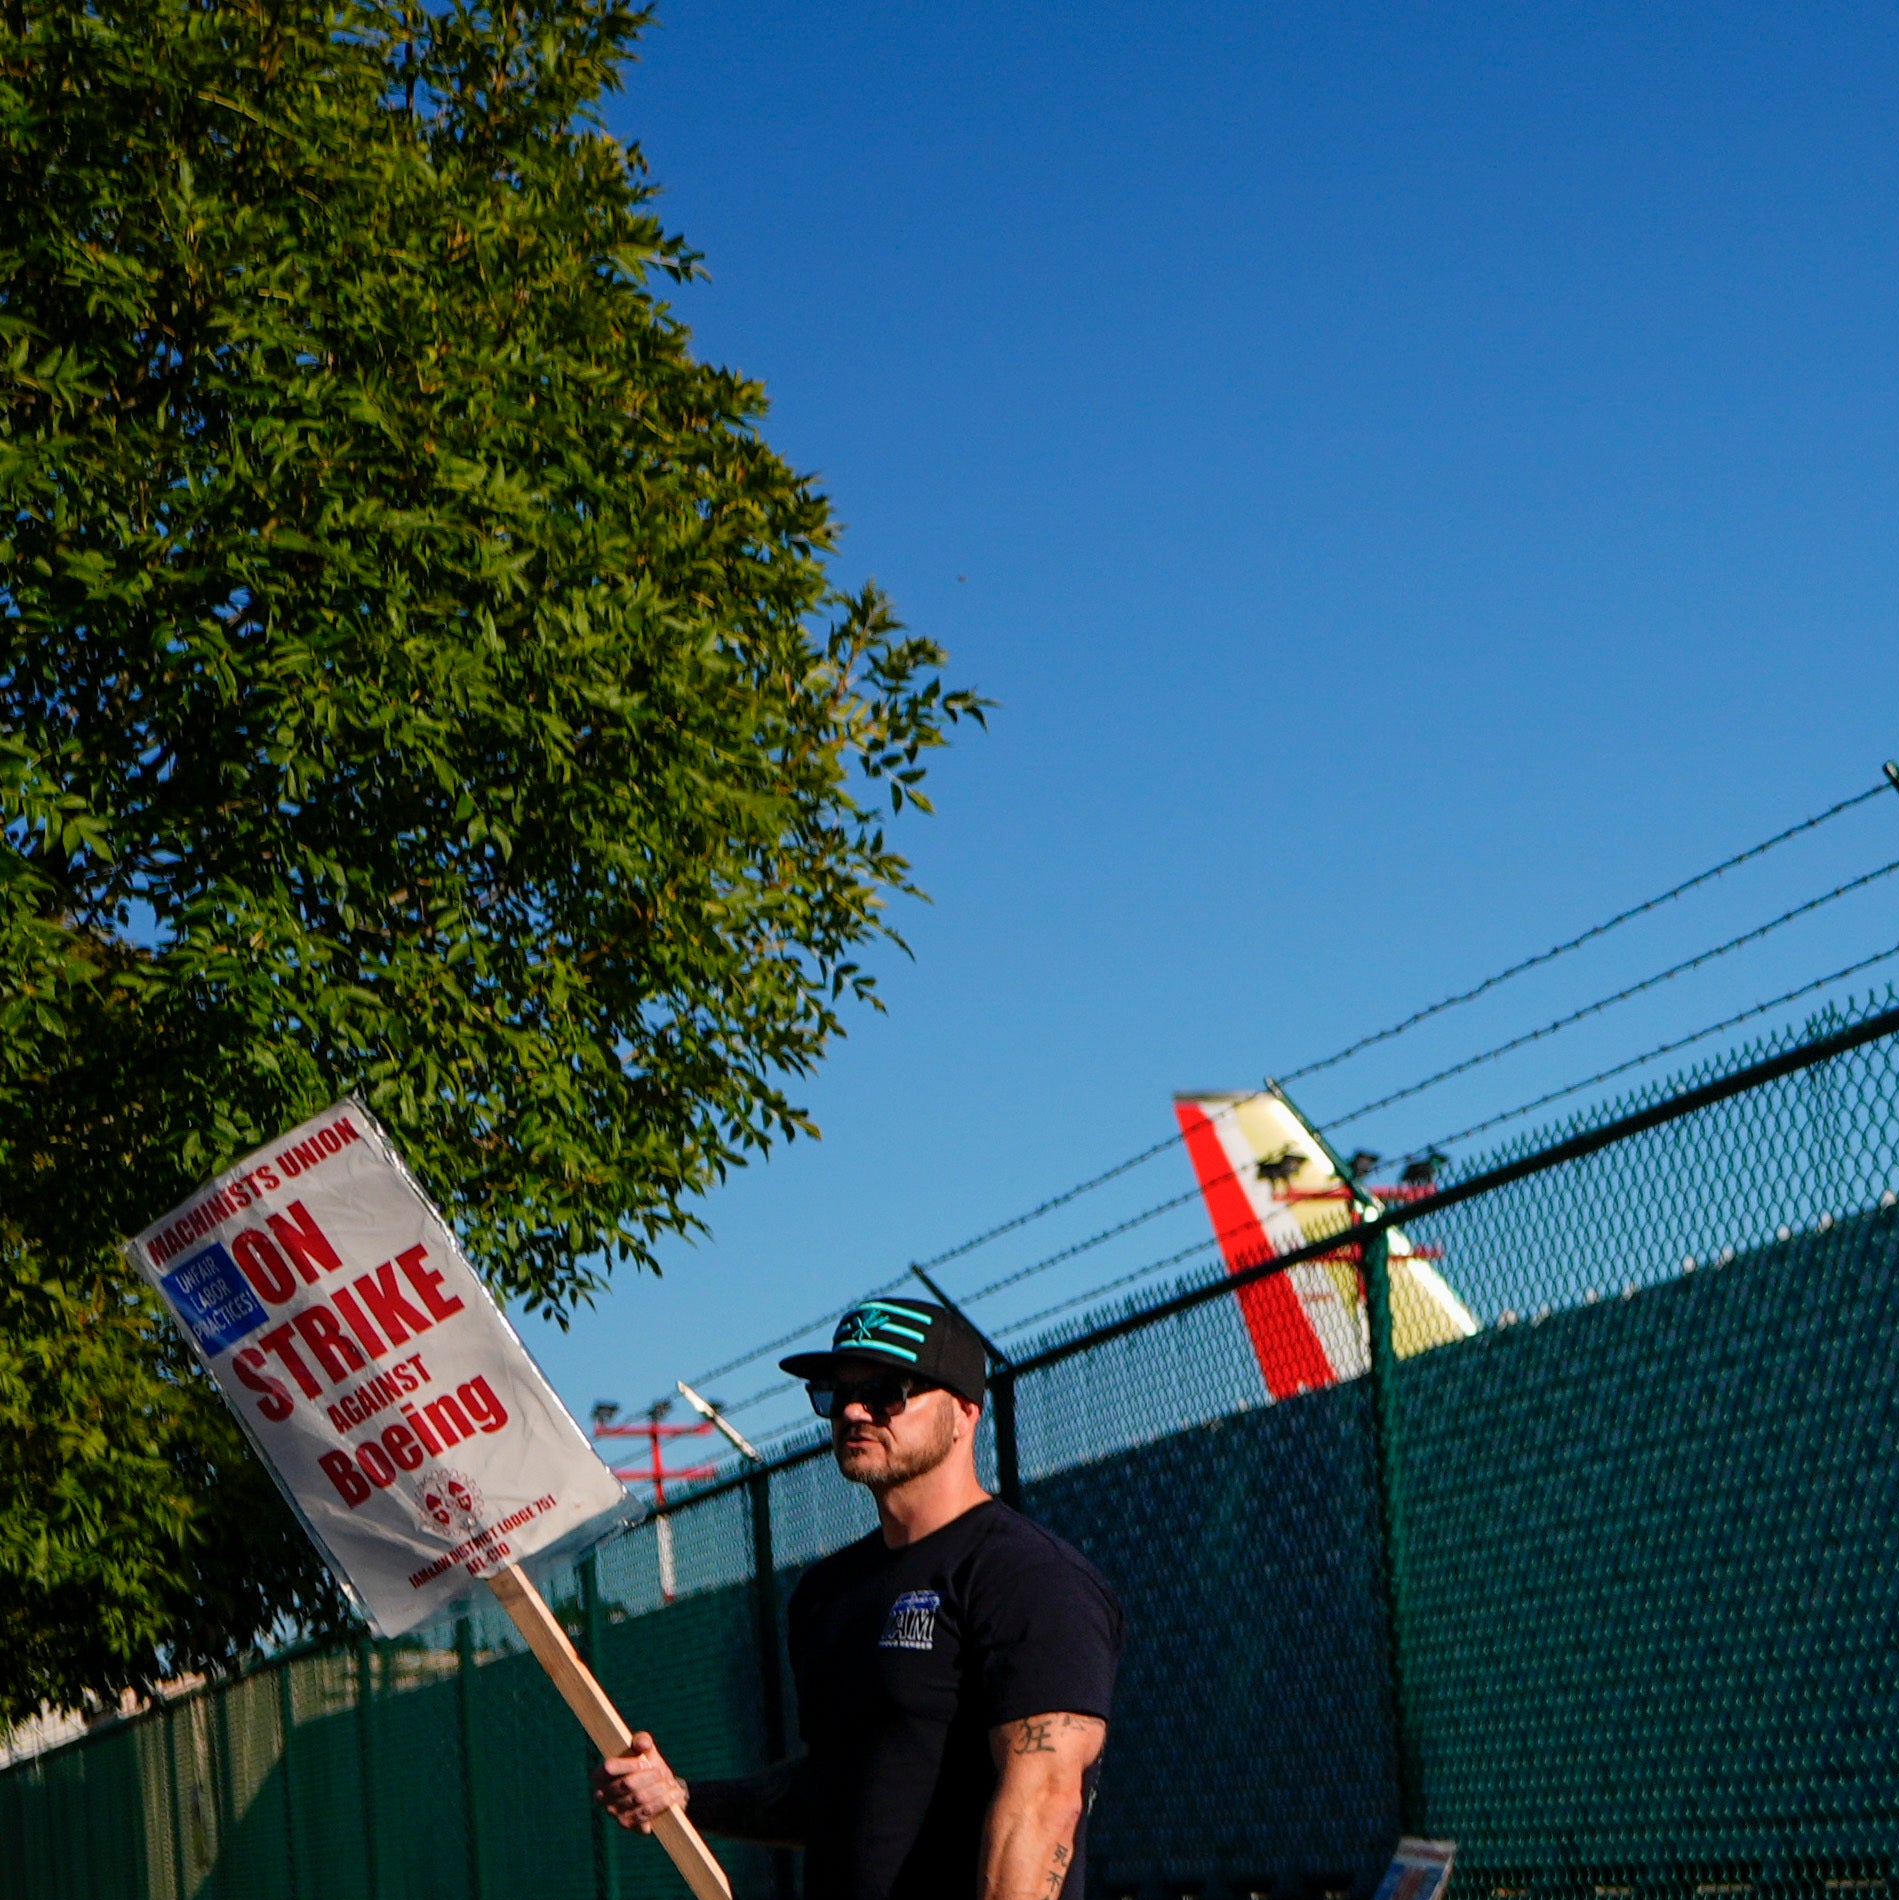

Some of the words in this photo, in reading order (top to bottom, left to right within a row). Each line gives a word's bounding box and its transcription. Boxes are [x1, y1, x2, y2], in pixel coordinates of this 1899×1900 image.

[146, 1164, 281, 1267] MACHINISTS
[276, 1117, 362, 1179] UNION
[174, 1255, 221, 1294] UNFAIR
[189, 1277, 232, 1315] LABOR
[232, 1199, 343, 1305] ON
[232, 1243, 465, 1422] STRIKE
[326, 1353, 432, 1434] AGAINST
[318, 1375, 509, 1508] Boeing
[449, 1525, 500, 1565] DISTRICT
[497, 1504, 537, 1535] LODGE
[533, 1493, 558, 1514] 751
